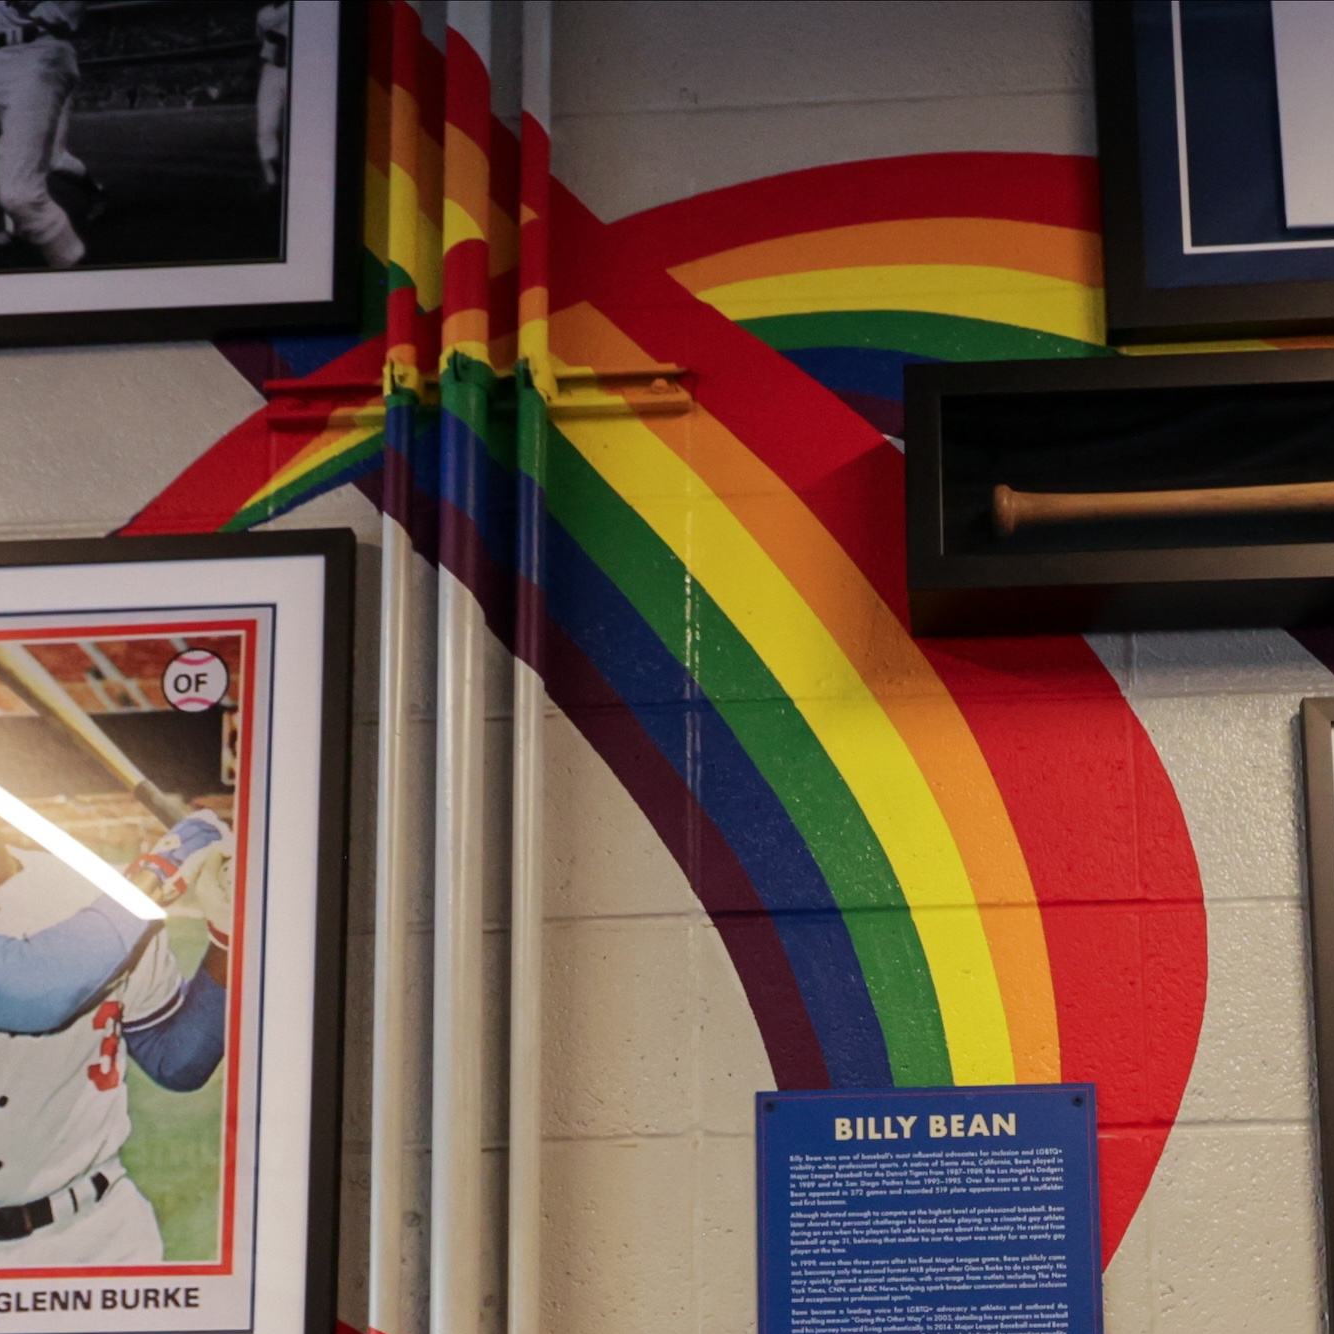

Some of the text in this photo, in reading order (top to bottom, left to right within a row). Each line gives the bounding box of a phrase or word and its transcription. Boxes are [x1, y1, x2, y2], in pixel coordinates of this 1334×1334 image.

[173, 673, 209, 694] OF
[87, 1000, 124, 1092] 3
[834, 1113, 1017, 1141] BILLY BEAN
[789, 1155, 803, 1163] Billy
[1036, 1148, 1062, 1156] LGBTQ+
[790, 1163, 815, 1171] visibility
[838, 1162, 877, 1170] professional
[1033, 1157, 1055, 1165] played
[790, 1173, 809, 1181] Major
[811, 1172, 833, 1180] League
[1009, 1167, 1035, 1175] Angeles
[1036, 1166, 1064, 1174] Dodgers
[860, 1180, 879, 1188] Diego
[809, 1190, 840, 1198] appeared
[843, 1219, 871, 1227] personal
[872, 1218, 906, 1227] challenges
[957, 1216, 982, 1224] playing
[935, 1256, 954, 1265] Major
[956, 1256, 979, 1264] League
[1021, 1254, 1046, 1262] publicly
[101, 1287, 200, 1310] BURKE
[846, 1307, 871, 1316] leading
[907, 1306, 933, 1314] LGBTQ+
[936, 1305, 968, 1313] advocacy
